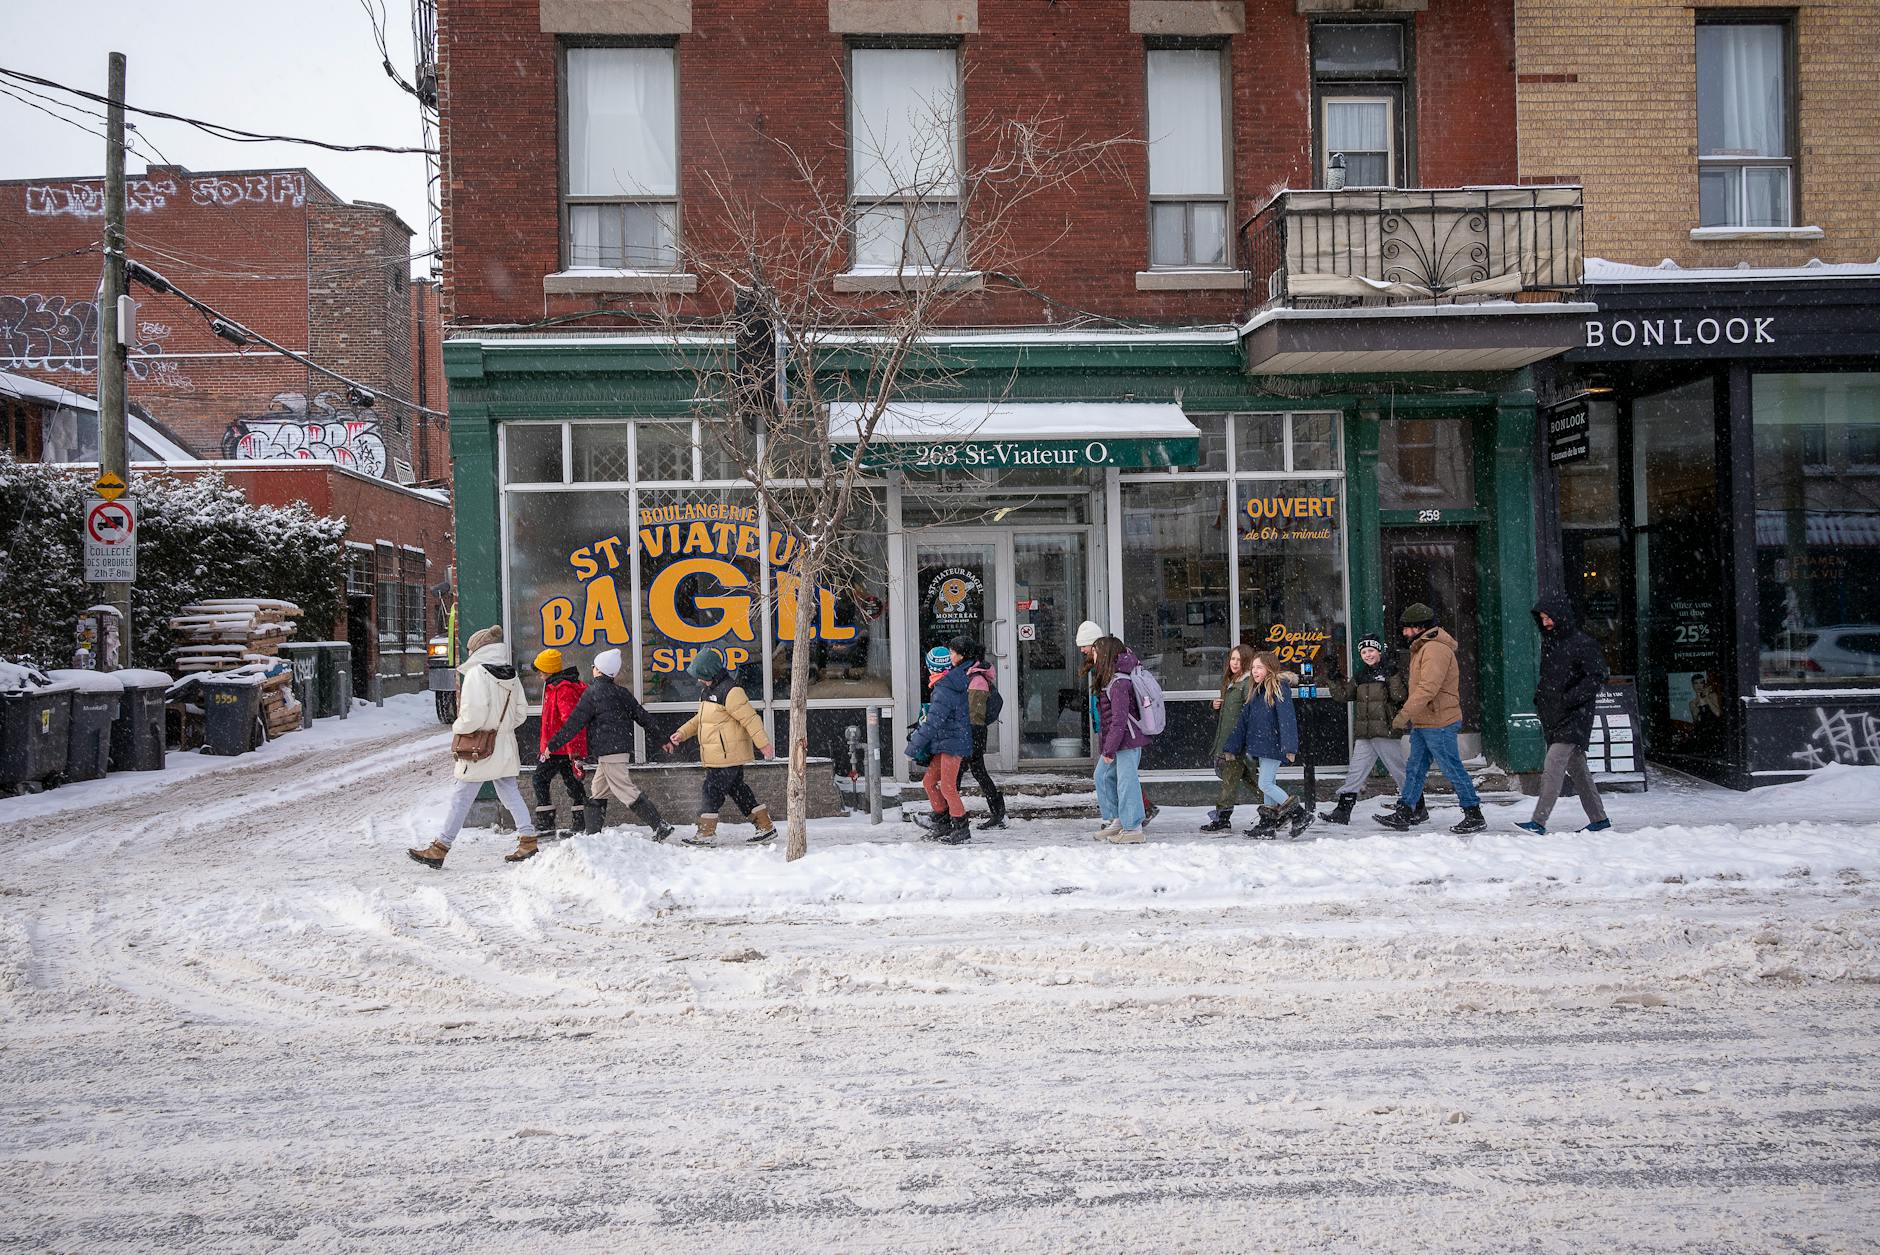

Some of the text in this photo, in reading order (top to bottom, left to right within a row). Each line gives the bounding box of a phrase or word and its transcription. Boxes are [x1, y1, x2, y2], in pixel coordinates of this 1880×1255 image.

[1585, 317, 1776, 347] BONLOOK
[1550, 411, 1586, 433] BONLOOK
[915, 441, 1115, 466] 263 St-Viateur O.
[640, 503, 759, 526] BOULANGERIE
[1246, 496, 1336, 519] OUVERT
[1418, 509, 1440, 523] 259
[1243, 528, 1261, 540] de
[1261, 526, 1279, 540] 6h
[1291, 527, 1332, 540] minuit
[90, 546, 132, 556] COLLECTE
[87, 558, 134, 568] DES ORDURES
[928, 568, 984, 596] ST-VIATEUR BAGEL
[936, 611, 978, 619] MONTRÉAL
[1264, 623, 1332, 645] Depuis
[1674, 624, 1710, 643] 25%
[652, 646, 750, 674] SHP
[1271, 644, 1321, 663] 1957
